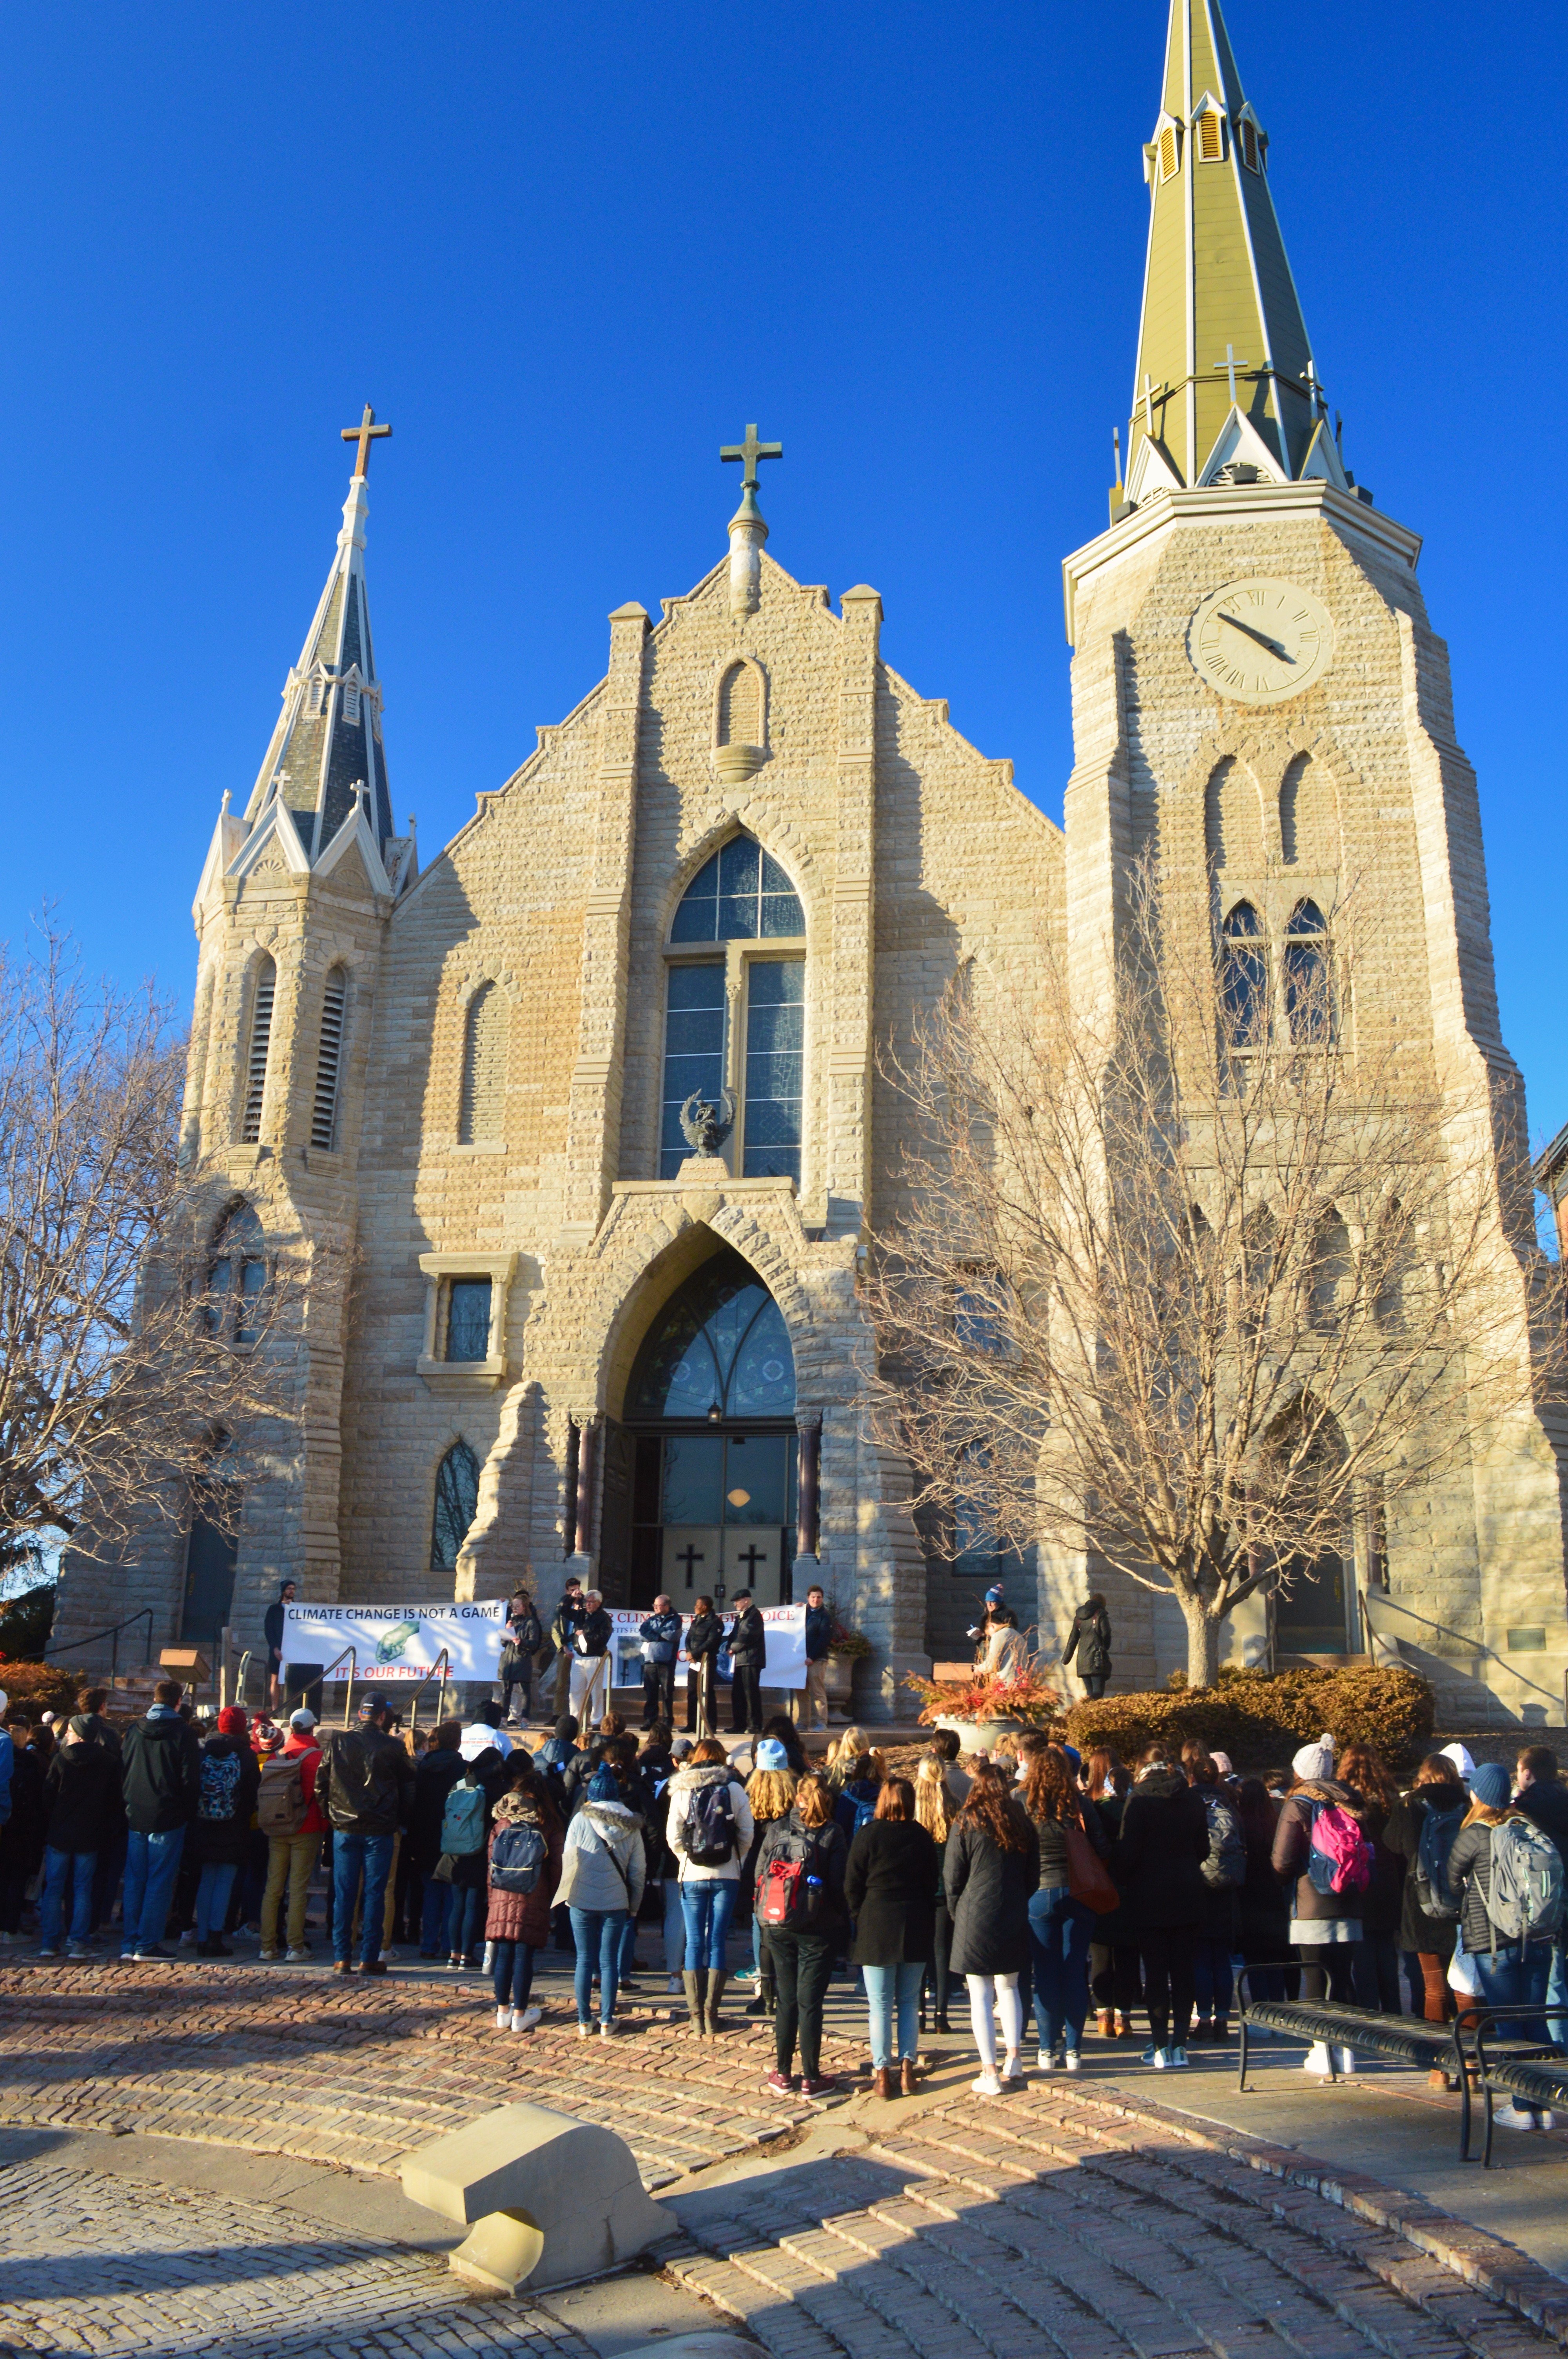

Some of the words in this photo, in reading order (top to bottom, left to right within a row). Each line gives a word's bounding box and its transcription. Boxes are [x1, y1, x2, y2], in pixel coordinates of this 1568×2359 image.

[289, 1609, 342, 1619] CLIMATE
[346, 1608, 400, 1619] CHANGE
[404, 1608, 415, 1619] IS
[419, 1608, 445, 1618] NOT
[449, 1608, 457, 1618] A
[462, 1607, 499, 1618] GAME
[365, 1667, 394, 1677] OUR
